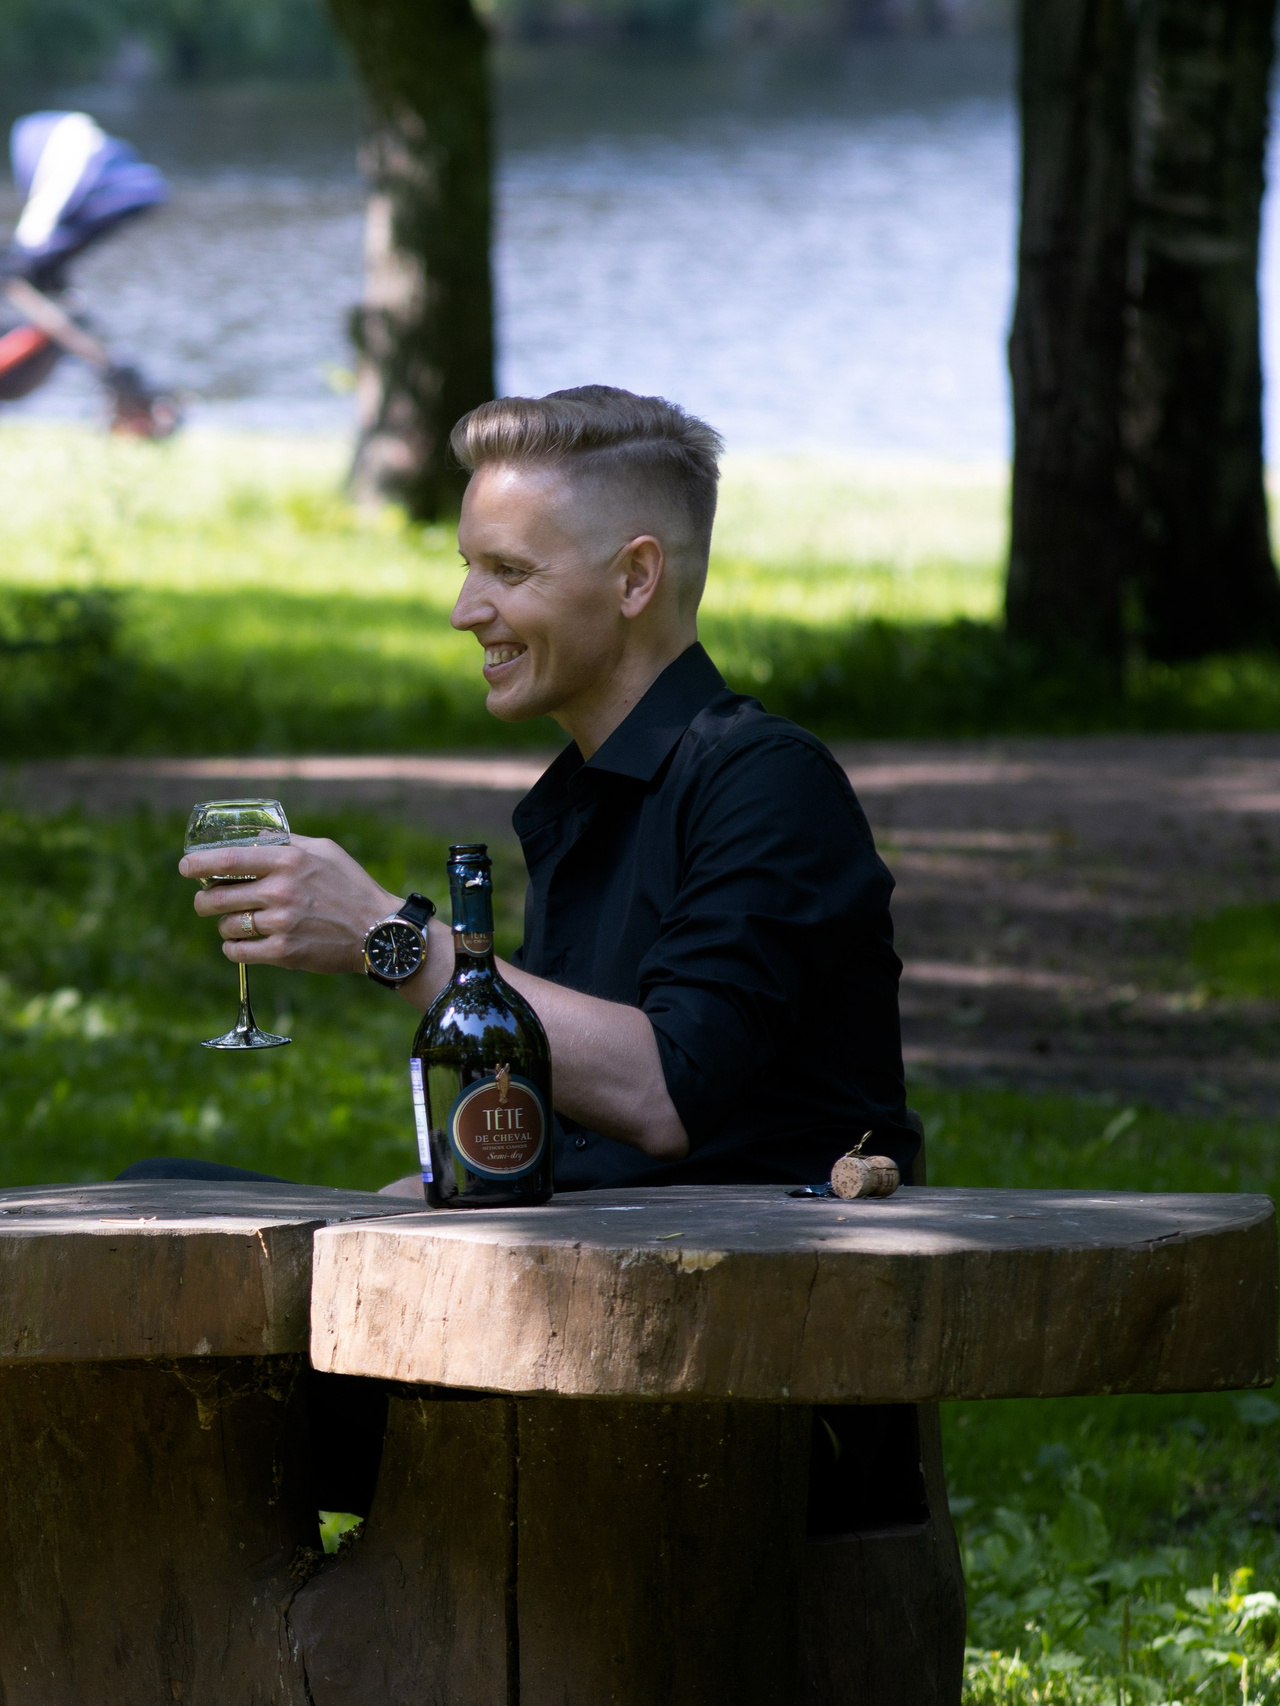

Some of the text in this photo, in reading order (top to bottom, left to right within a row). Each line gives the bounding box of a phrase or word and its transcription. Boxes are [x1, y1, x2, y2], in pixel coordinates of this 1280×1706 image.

[482, 1107, 524, 1130] TÊTE
[475, 1133, 532, 1143] DE CHEVAL
[487, 1151, 523, 1161] Semi-dry
